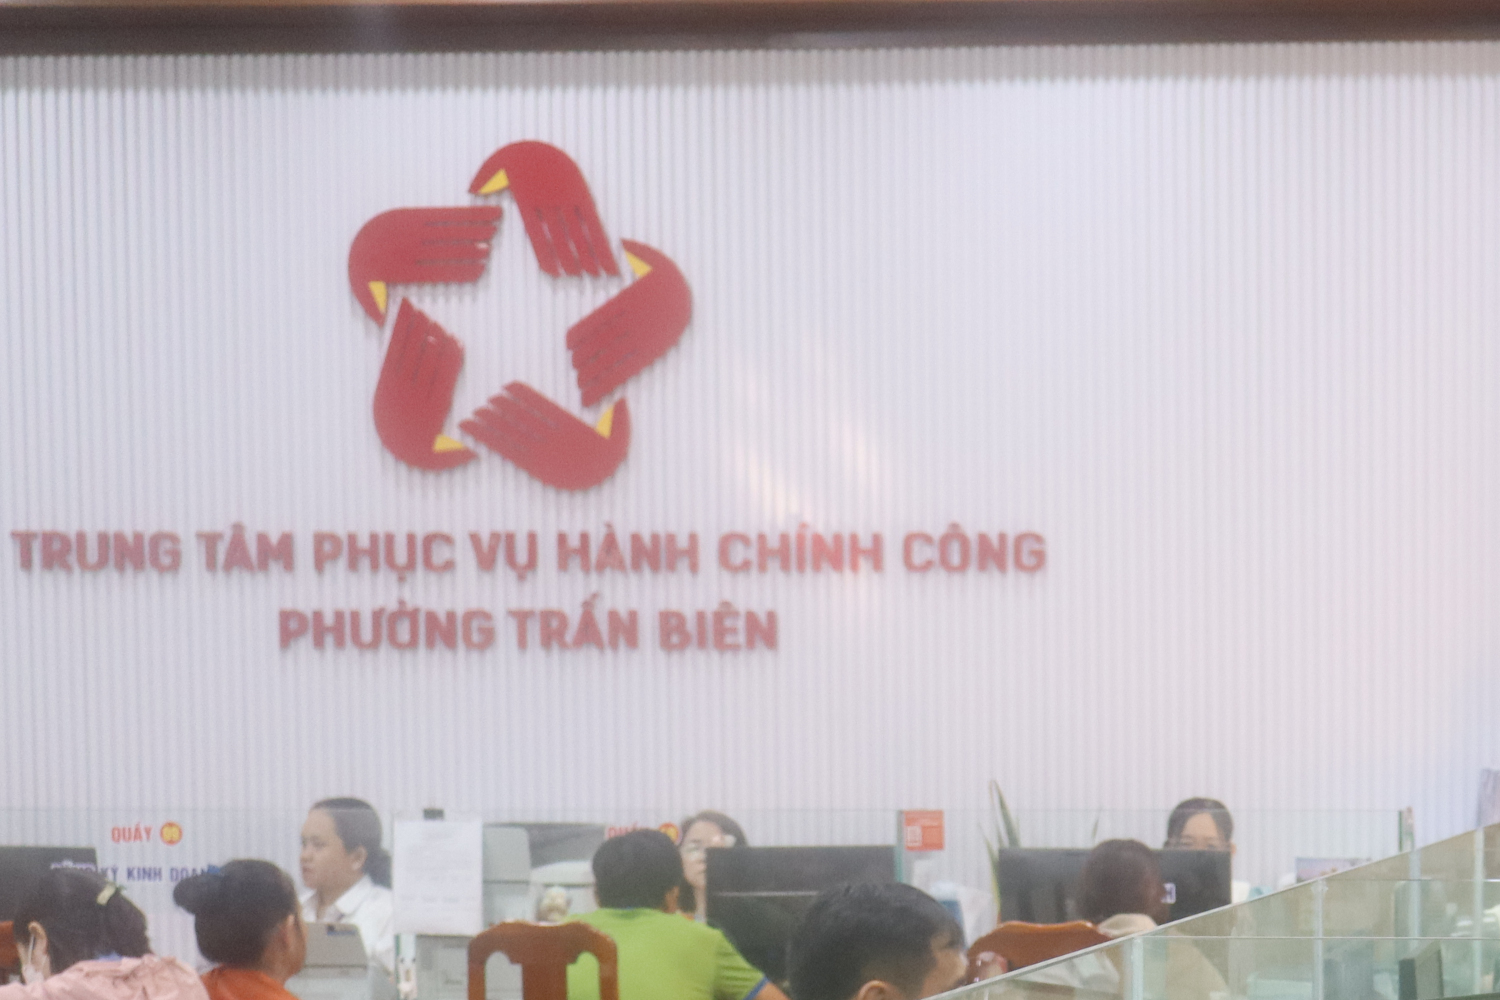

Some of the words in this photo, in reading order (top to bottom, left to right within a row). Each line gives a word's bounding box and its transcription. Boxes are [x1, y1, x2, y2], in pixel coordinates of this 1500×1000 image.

[12, 530, 182, 572] TRUNG
[196, 521, 295, 572] TÂM
[313, 530, 456, 582] PHỤC
[470, 530, 538, 581] VỤ
[557, 521, 699, 573] HÀNH
[718, 521, 884, 573] CHÍNH
[903, 521, 1047, 573] CÔNG
[279, 599, 495, 651] PHƯỜNG
[508, 592, 639, 651] TRẤN
[658, 600, 779, 651] BIÊN
[127, 867, 163, 882] KINH
